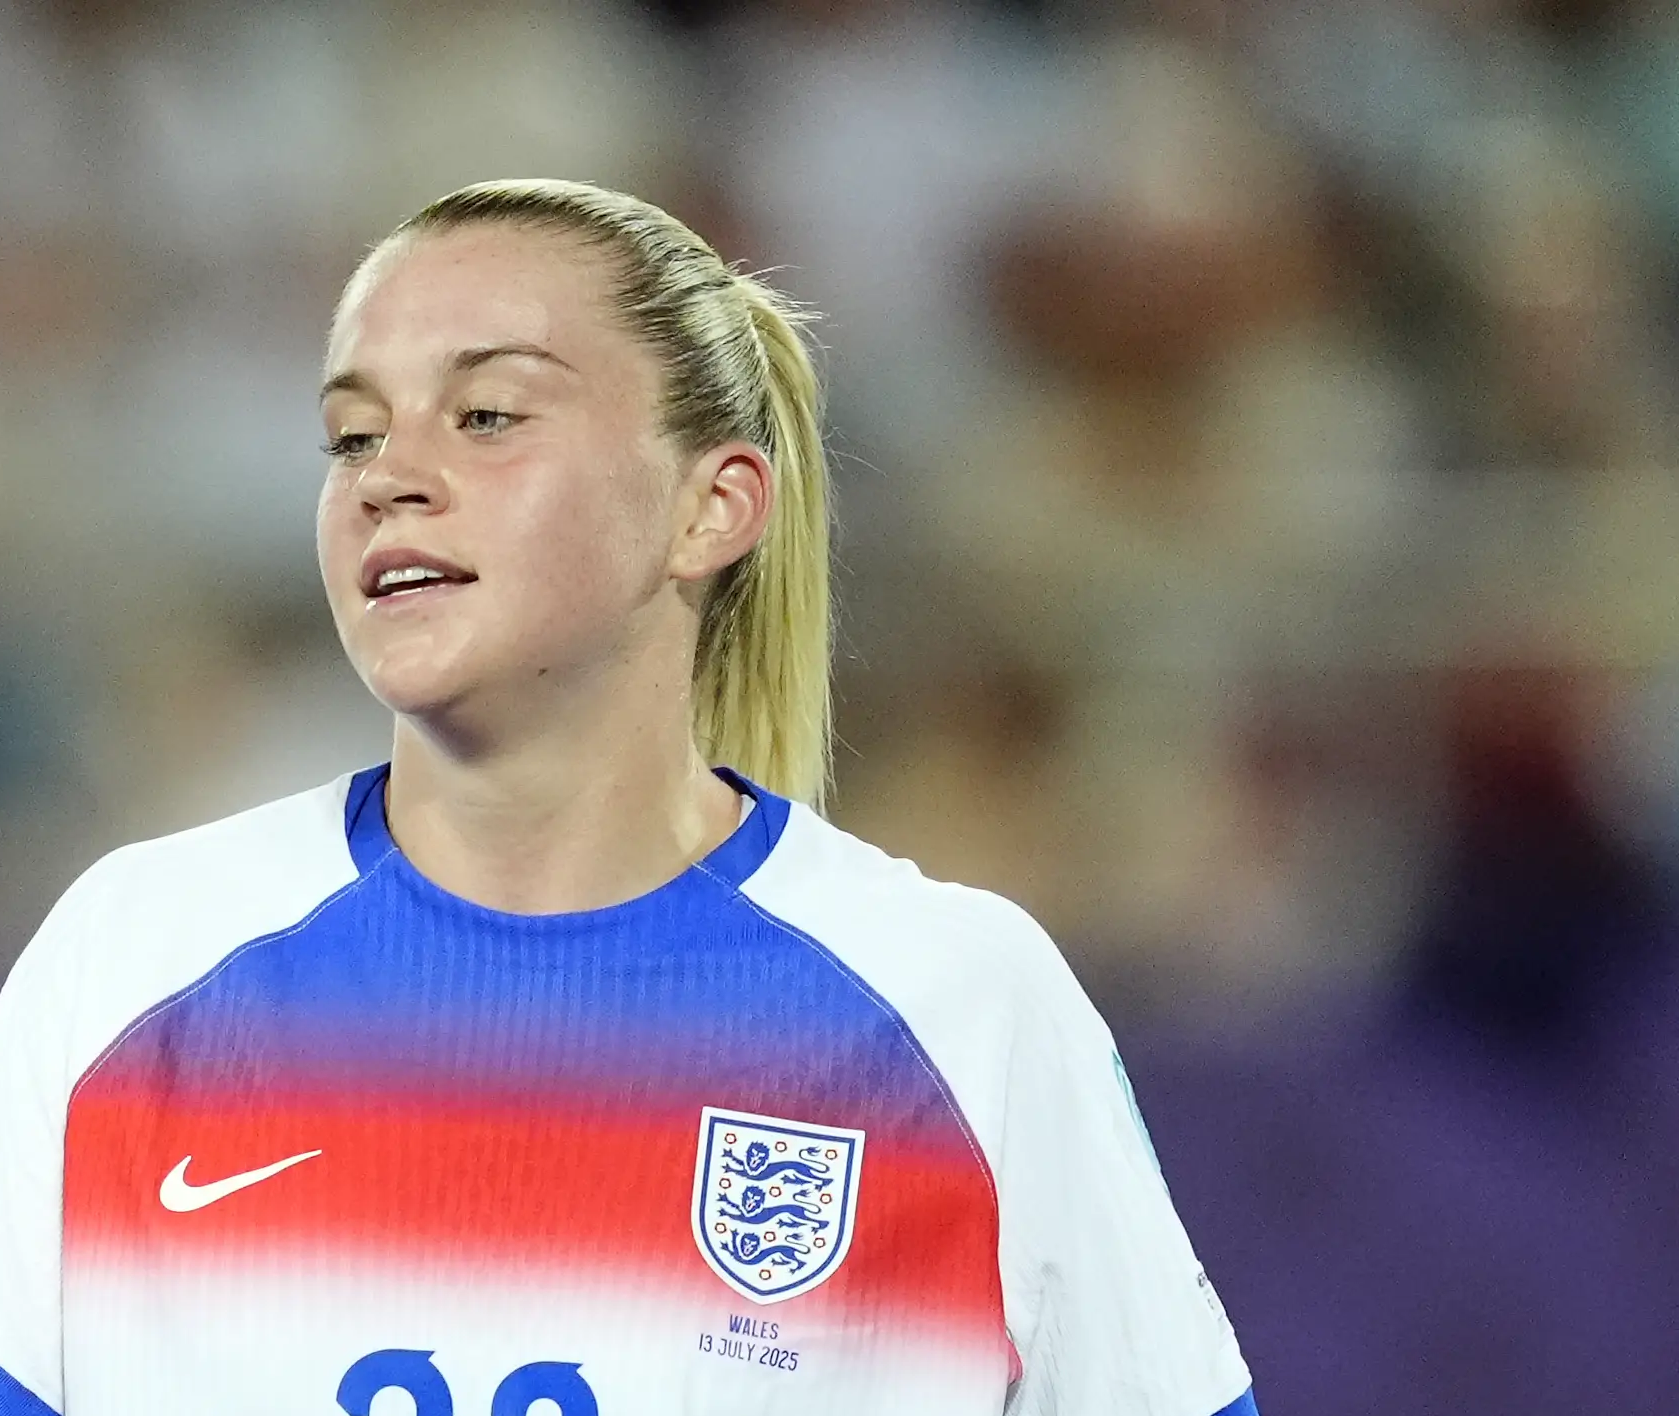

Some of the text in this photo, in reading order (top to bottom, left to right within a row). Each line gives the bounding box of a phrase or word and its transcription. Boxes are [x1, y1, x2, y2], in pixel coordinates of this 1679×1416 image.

[729, 1314, 779, 1340] WALES
[699, 1333, 799, 1371] 13 JULY 2025
